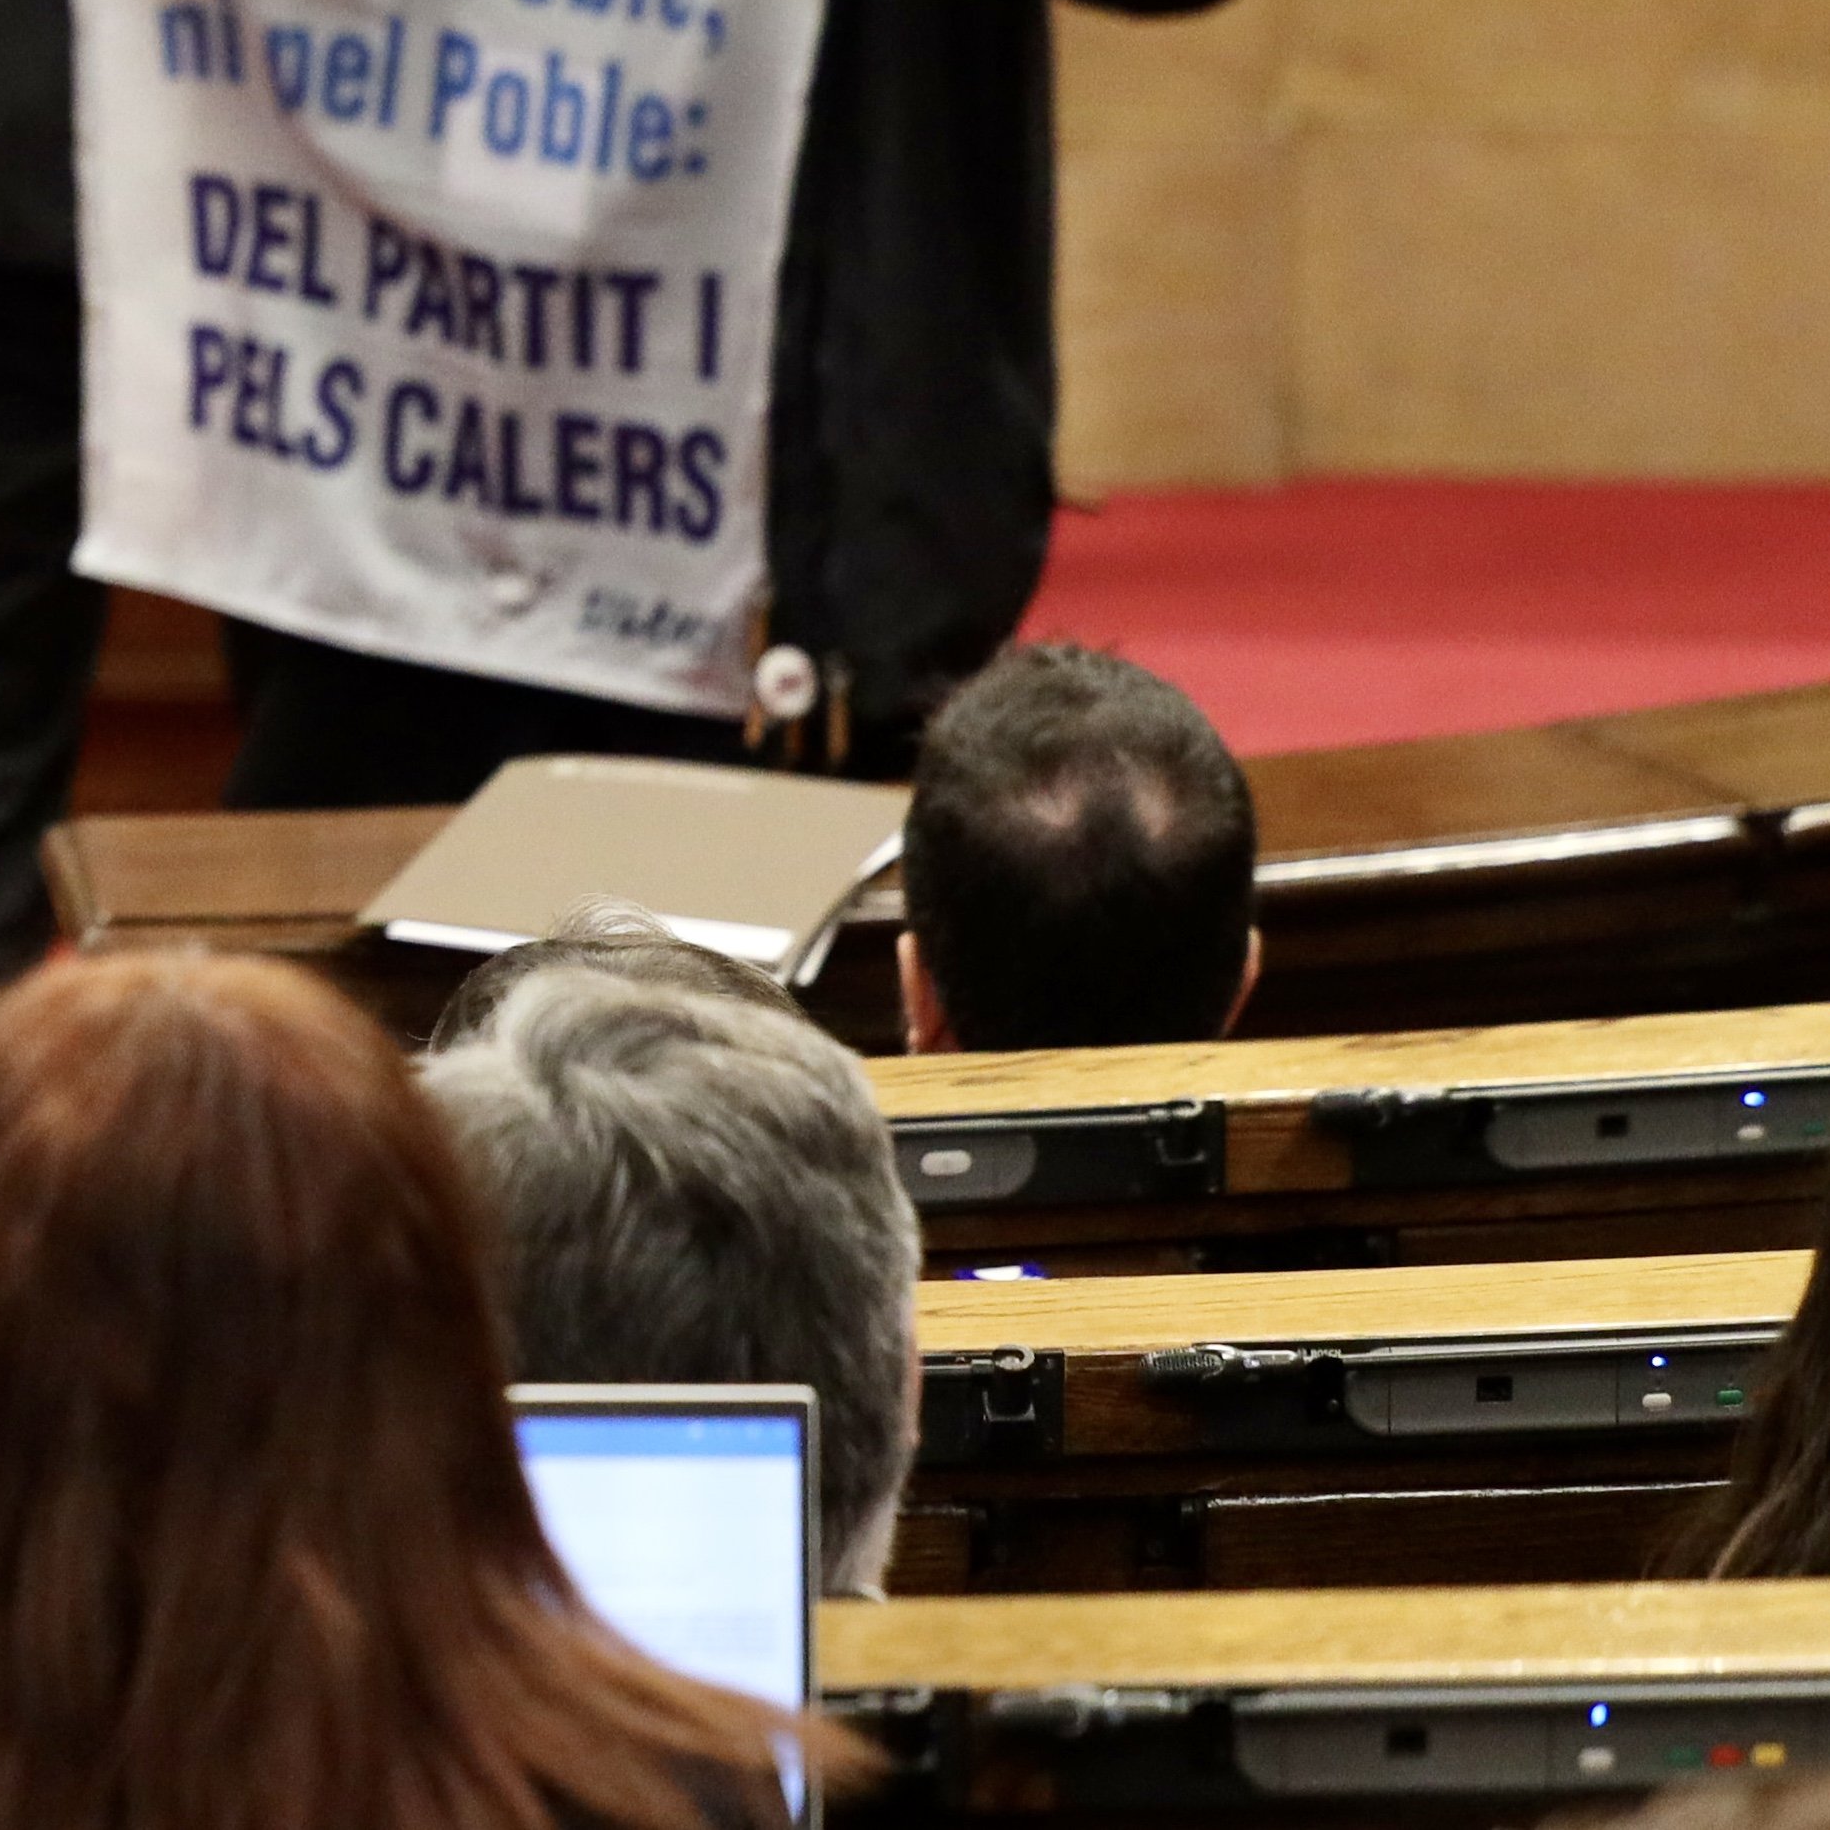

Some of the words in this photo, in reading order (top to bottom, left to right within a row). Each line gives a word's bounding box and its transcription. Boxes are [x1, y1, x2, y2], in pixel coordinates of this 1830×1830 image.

[429, 27, 708, 182] Poble:
[189, 174, 337, 308] DEL
[363, 214, 658, 374] PARTIT
[187, 324, 366, 474] PELS
[383, 381, 727, 546] CALERS
